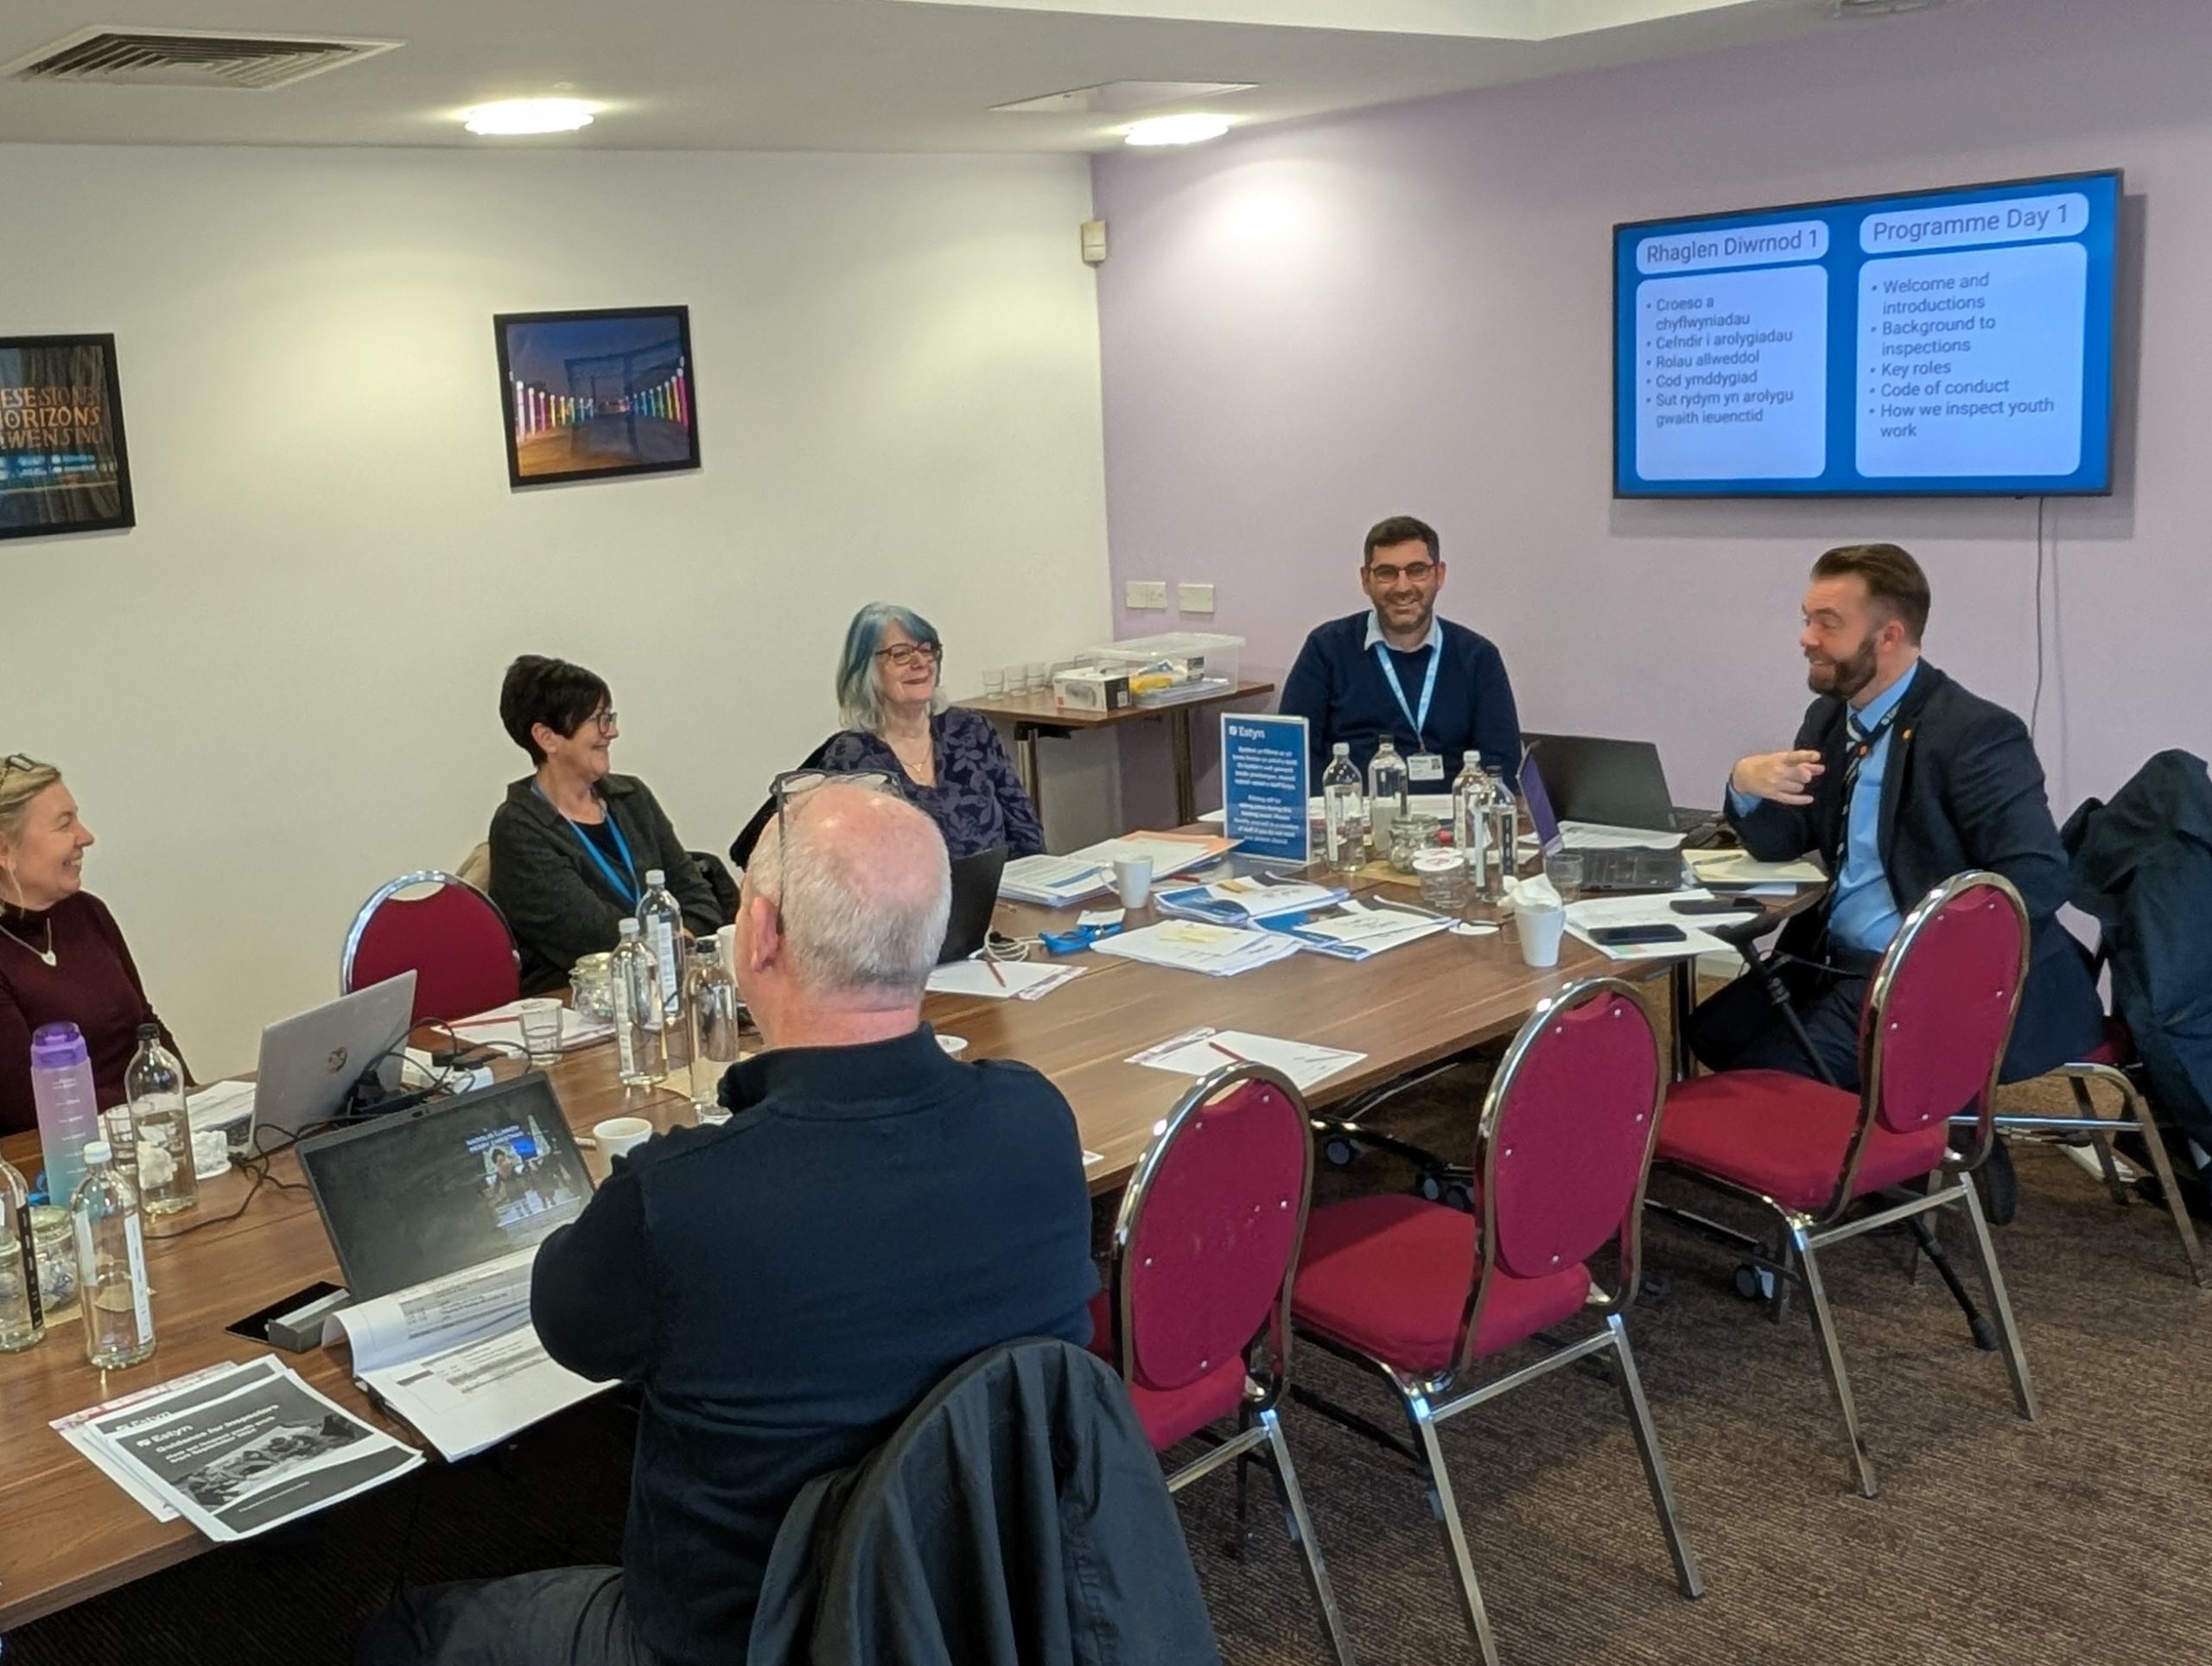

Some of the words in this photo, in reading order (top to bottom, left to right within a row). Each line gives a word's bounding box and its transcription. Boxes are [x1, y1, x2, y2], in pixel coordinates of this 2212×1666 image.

[1873, 214, 2000, 242] Programme
[2006, 208, 2050, 232] Day
[2057, 203, 2067, 223] 1
[1647, 240, 1718, 264] Rhaglen
[1724, 230, 1802, 256] Diwrnod
[1808, 229, 1817, 248] 1
[1883, 277, 1955, 295] Welcome
[1960, 271, 1990, 289] and
[1656, 297, 1702, 312] Croeso
[1706, 297, 1714, 308] a
[1883, 296, 1986, 315] introductions
[1656, 312, 1751, 334] chyflwyniadau
[1882, 315, 1975, 336] Background
[1980, 316, 1996, 330] to
[1656, 334, 1703, 350] Cefndir
[1706, 334, 1710, 347] i
[1713, 328, 1793, 347] arolygiadau
[1881, 339, 1971, 358] inspections
[1656, 354, 1693, 369] Rolau
[1695, 350, 1760, 366] allweddol
[1881, 362, 1910, 378] Key
[1912, 360, 1952, 375] roles
[1656, 373, 1681, 387] Cod
[1685, 370, 1758, 390] ymddygiad
[1880, 382, 1921, 397] Code
[1924, 379, 1942, 396] of
[1944, 378, 2010, 395] conduct
[1656, 393, 1677, 407] Sut
[1681, 392, 1720, 408] rydym
[1723, 391, 1739, 407] yn
[1743, 389, 1794, 404] arolygu
[1880, 403, 1916, 417] How
[1919, 403, 1942, 416] we
[1946, 400, 2005, 417] inspect
[2008, 397, 2055, 416] youth
[0, 406, 101, 429] ORIZONS
[1656, 411, 1699, 429] gwaith
[1702, 408, 1764, 423] ieuenctid
[1879, 423, 1917, 438] work
[150, 1425, 194, 1442] Estyn
